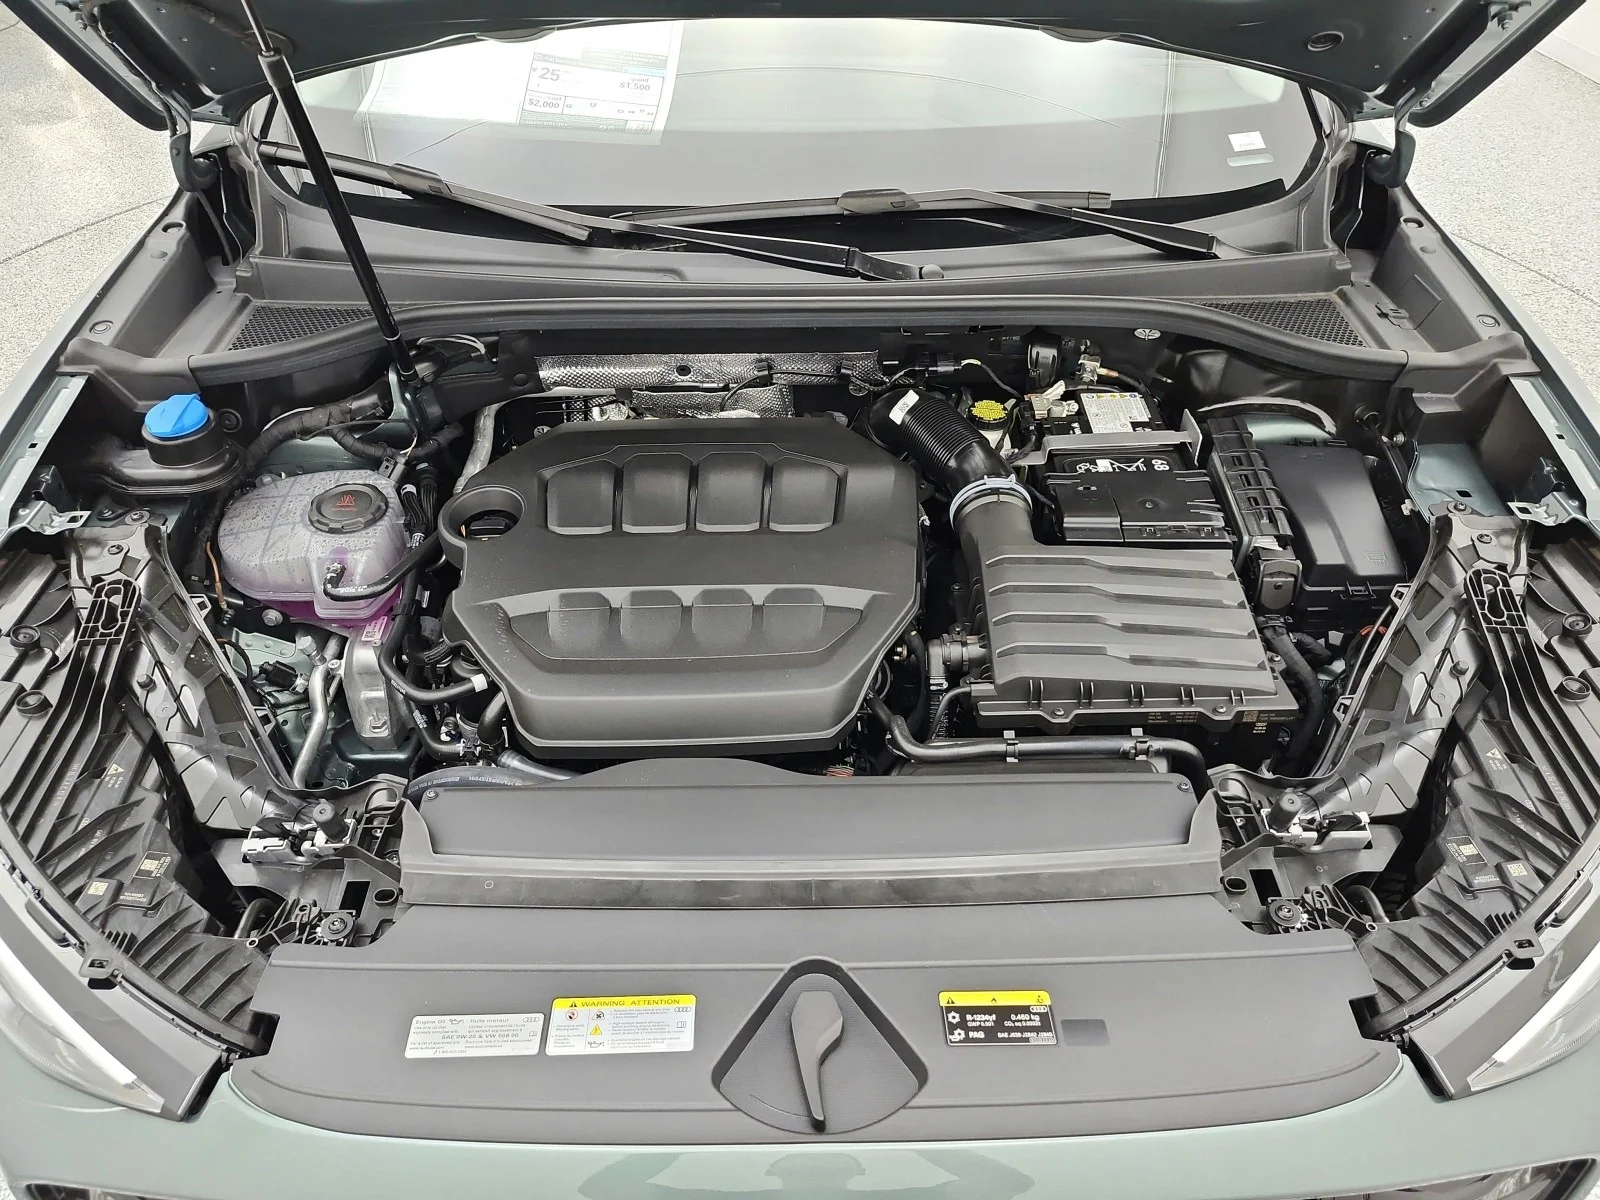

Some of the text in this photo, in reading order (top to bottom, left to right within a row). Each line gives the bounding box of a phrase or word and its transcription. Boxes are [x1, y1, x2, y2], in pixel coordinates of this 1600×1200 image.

[538, 67, 560, 82] 25
[620, 82, 651, 92] $1,500
[528, 98, 560, 109] $2,000
[966, 1014, 997, 1022] R-1234yf
[1030, 1014, 1040, 1022] kg
[968, 1030, 985, 1038] PAG
